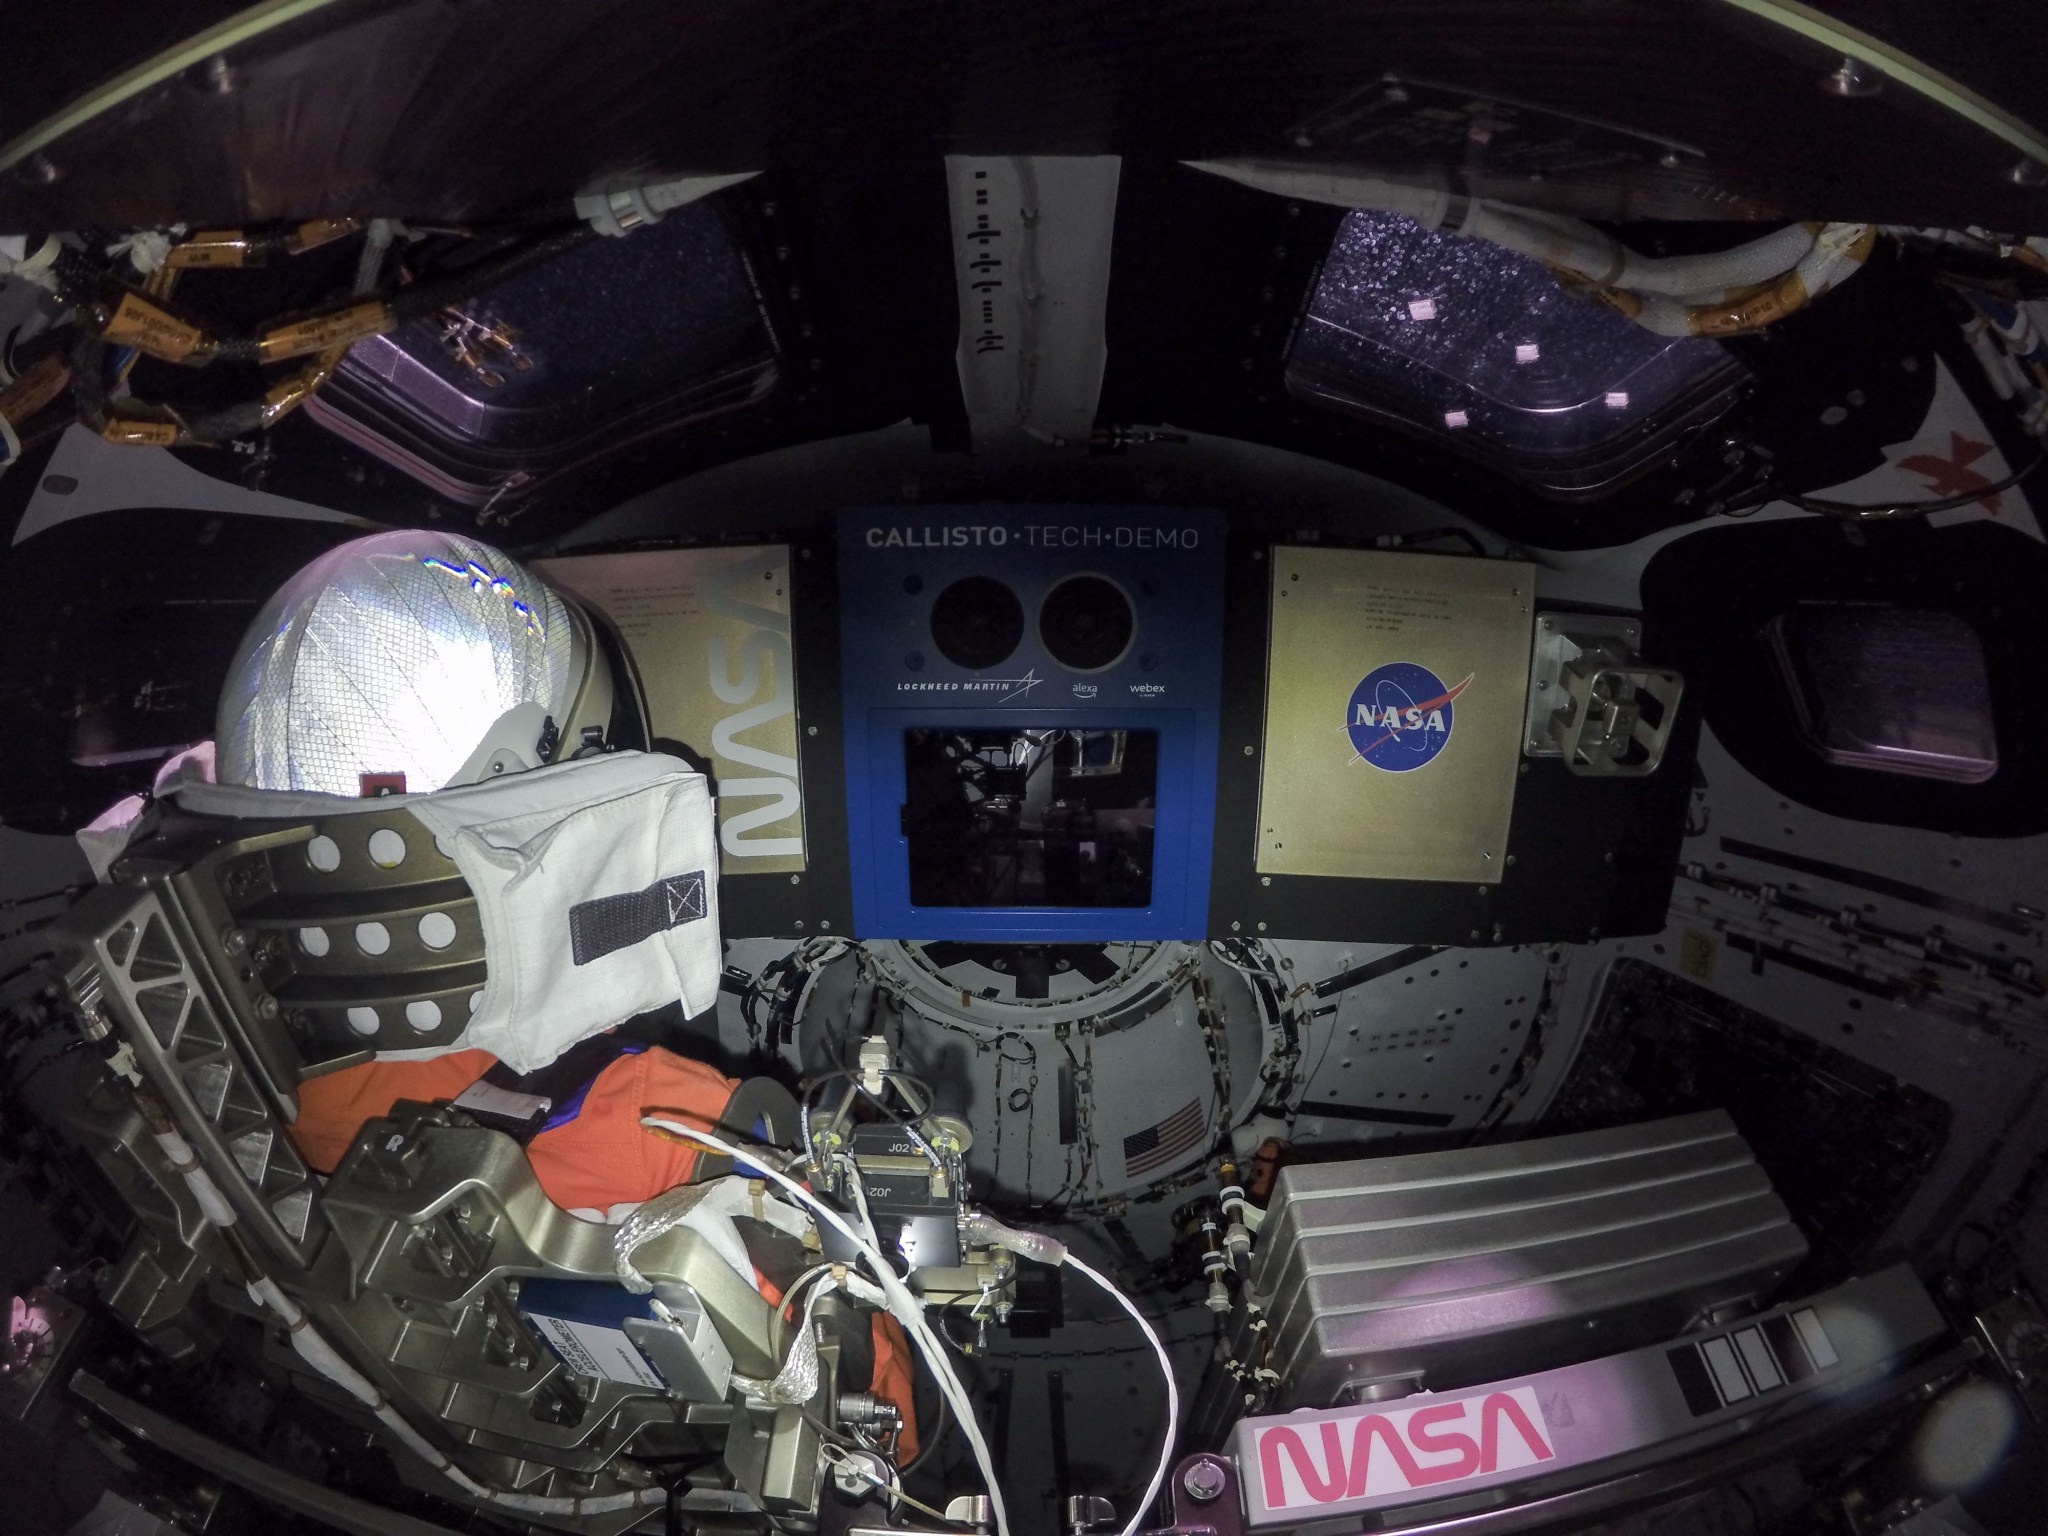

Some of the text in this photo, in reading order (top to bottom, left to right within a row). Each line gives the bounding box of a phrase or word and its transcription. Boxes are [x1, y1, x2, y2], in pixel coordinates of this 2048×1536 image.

[866, 526, 1199, 549] CALLISTO TECH DEMO
[897, 682, 1010, 691] LOCKHEED MARTIN
[1072, 682, 1098, 693] alexa
[1129, 682, 1165, 693] webex
[700, 546, 804, 857] NASA
[1354, 702, 1448, 733] NASA
[385, 1134, 404, 1152] R
[888, 1143, 910, 1153] J02
[548, 1318, 598, 1372] ACCELEROMETER
[553, 1340, 575, 1358] SEAT
[1260, 1391, 1554, 1508] NASA
